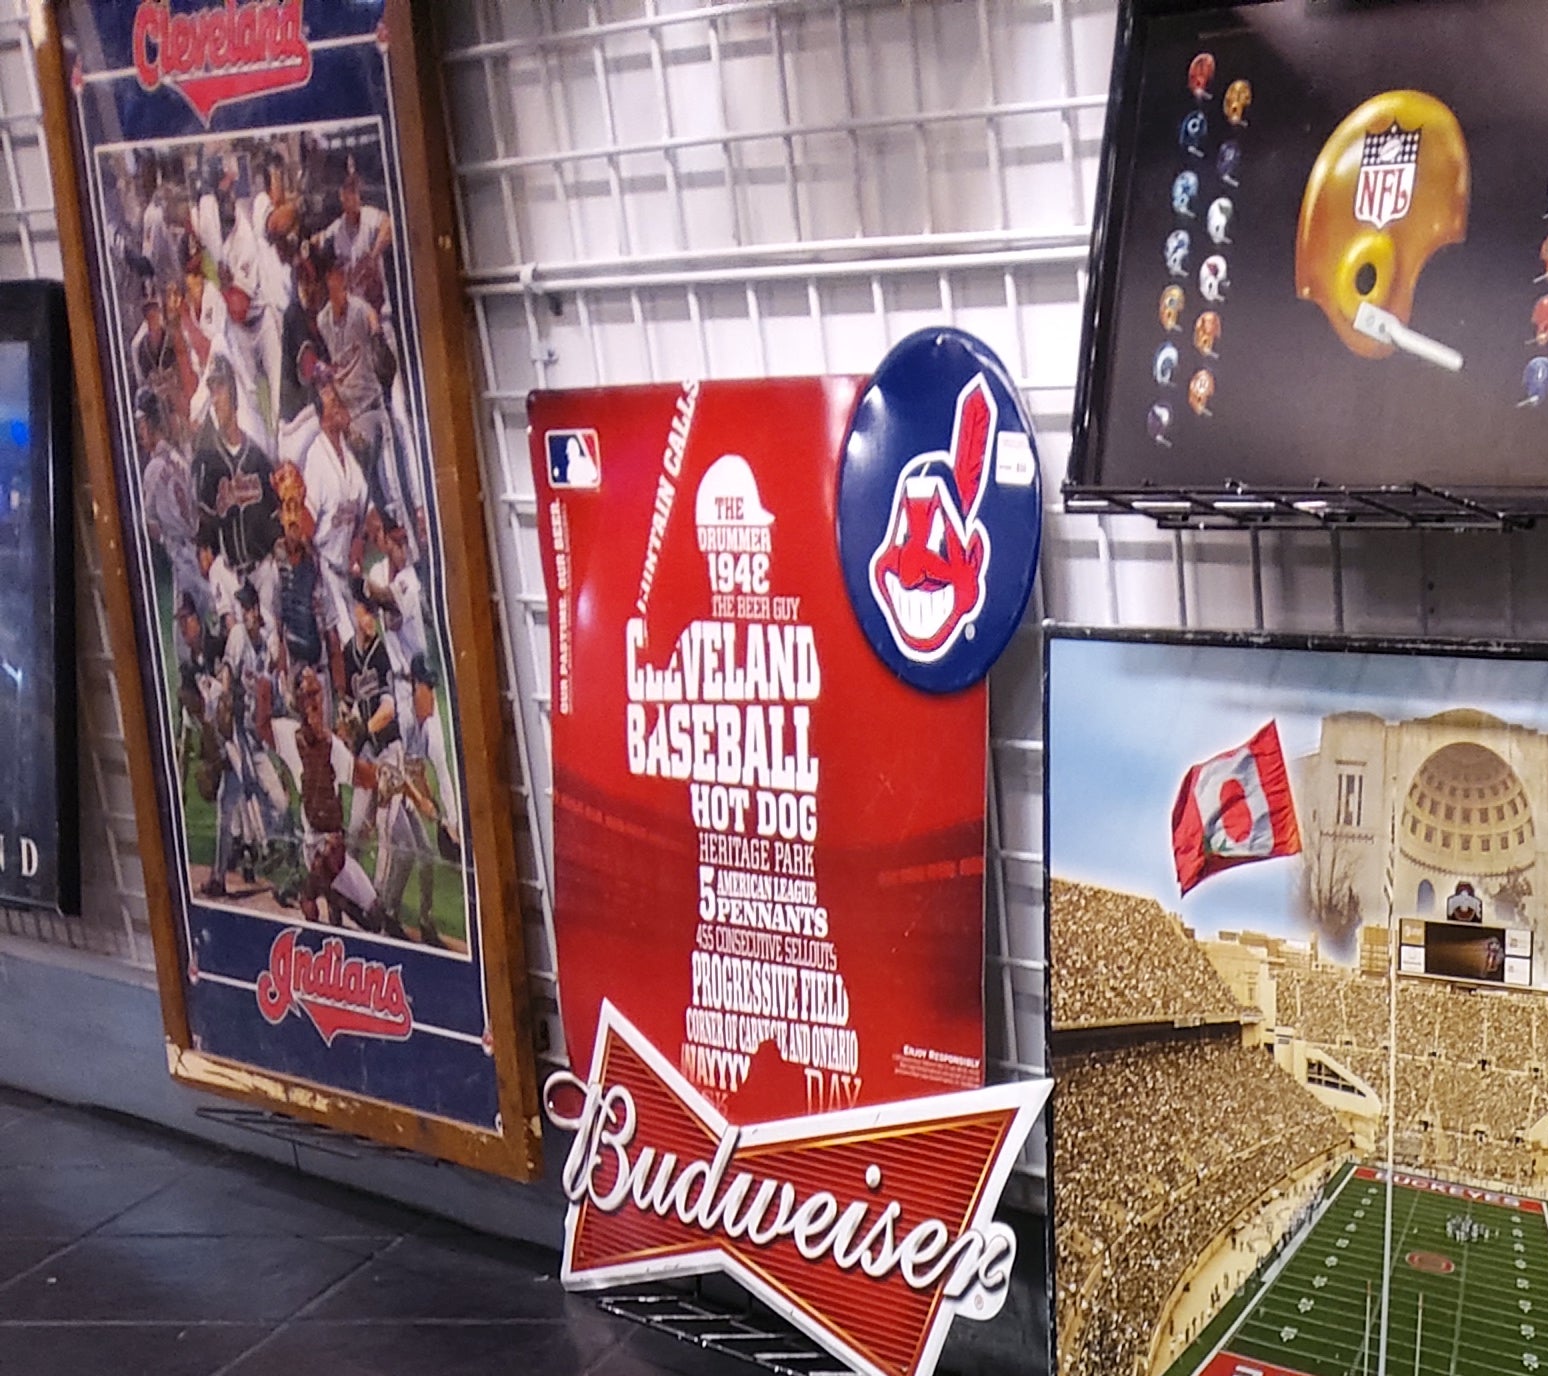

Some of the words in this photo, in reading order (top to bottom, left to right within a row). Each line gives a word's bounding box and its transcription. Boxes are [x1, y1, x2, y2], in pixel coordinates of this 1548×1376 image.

[133, 0, 312, 92] Cleveland
[1358, 168, 1408, 221] NFL
[664, 379, 700, 478] CALLS
[715, 497, 743, 520] THE
[698, 527, 772, 552] DRUMMER
[556, 553, 567, 590] OUR
[708, 553, 769, 594] 1948
[711, 595, 735, 618] THE
[737, 596, 770, 619] BEER
[773, 597, 800, 620] GUY
[627, 703, 818, 792] BASEBALL
[690, 783, 749, 832] HOT
[756, 790, 818, 842] DOG
[699, 832, 769, 871] HERITAGE
[774, 841, 815, 876] PARK
[699, 865, 716, 921] 5
[717, 871, 772, 900] AMERICAN
[774, 877, 817, 905] LEAGUE
[717, 897, 828, 938] PENNANTS
[696, 923, 714, 950] 455
[716, 926, 783, 962] CONSECUTIVE
[784, 937, 837, 971] SELLOUTS
[257, 927, 412, 1026] Indians
[691, 950, 798, 1019] PROGRESSIVE
[800, 970, 849, 1026] FIELD
[686, 1007, 724, 1048] CORNER
[725, 1012, 738, 1051] OF
[789, 1022, 811, 1066] AND
[812, 1025, 859, 1075] ONTARIO
[804, 1067, 862, 1115] DAY
[542, 1070, 1010, 1294] Budweiser
